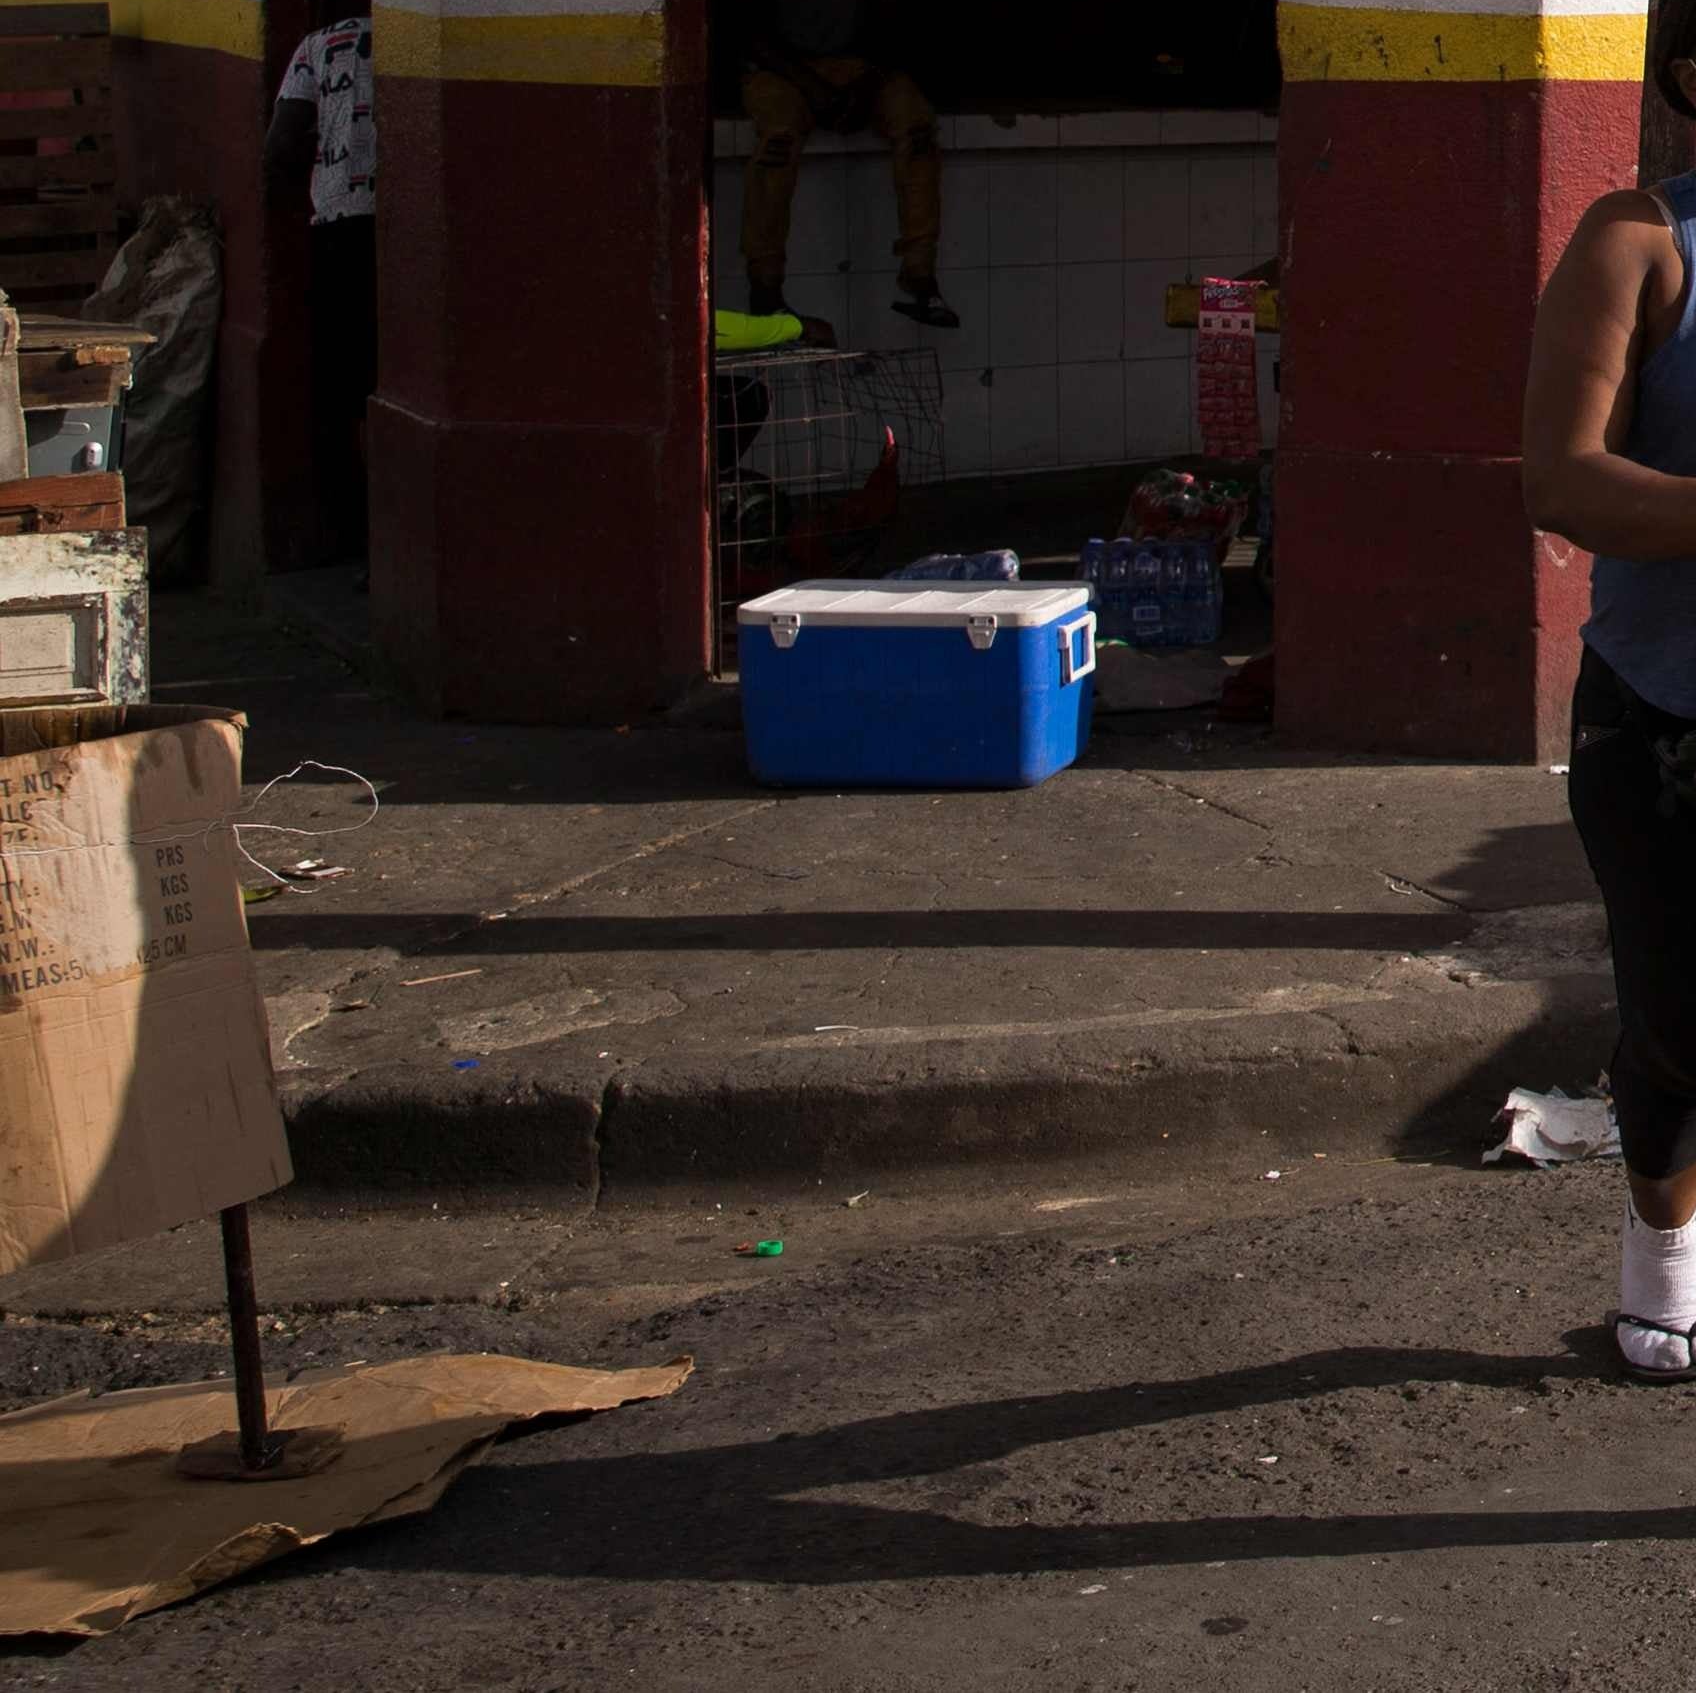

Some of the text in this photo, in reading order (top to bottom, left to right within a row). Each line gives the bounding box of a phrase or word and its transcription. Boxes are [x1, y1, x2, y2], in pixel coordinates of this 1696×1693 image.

[156, 844, 185, 868] PRS
[160, 873, 190, 897] KGS
[165, 901, 194, 926] KGS
